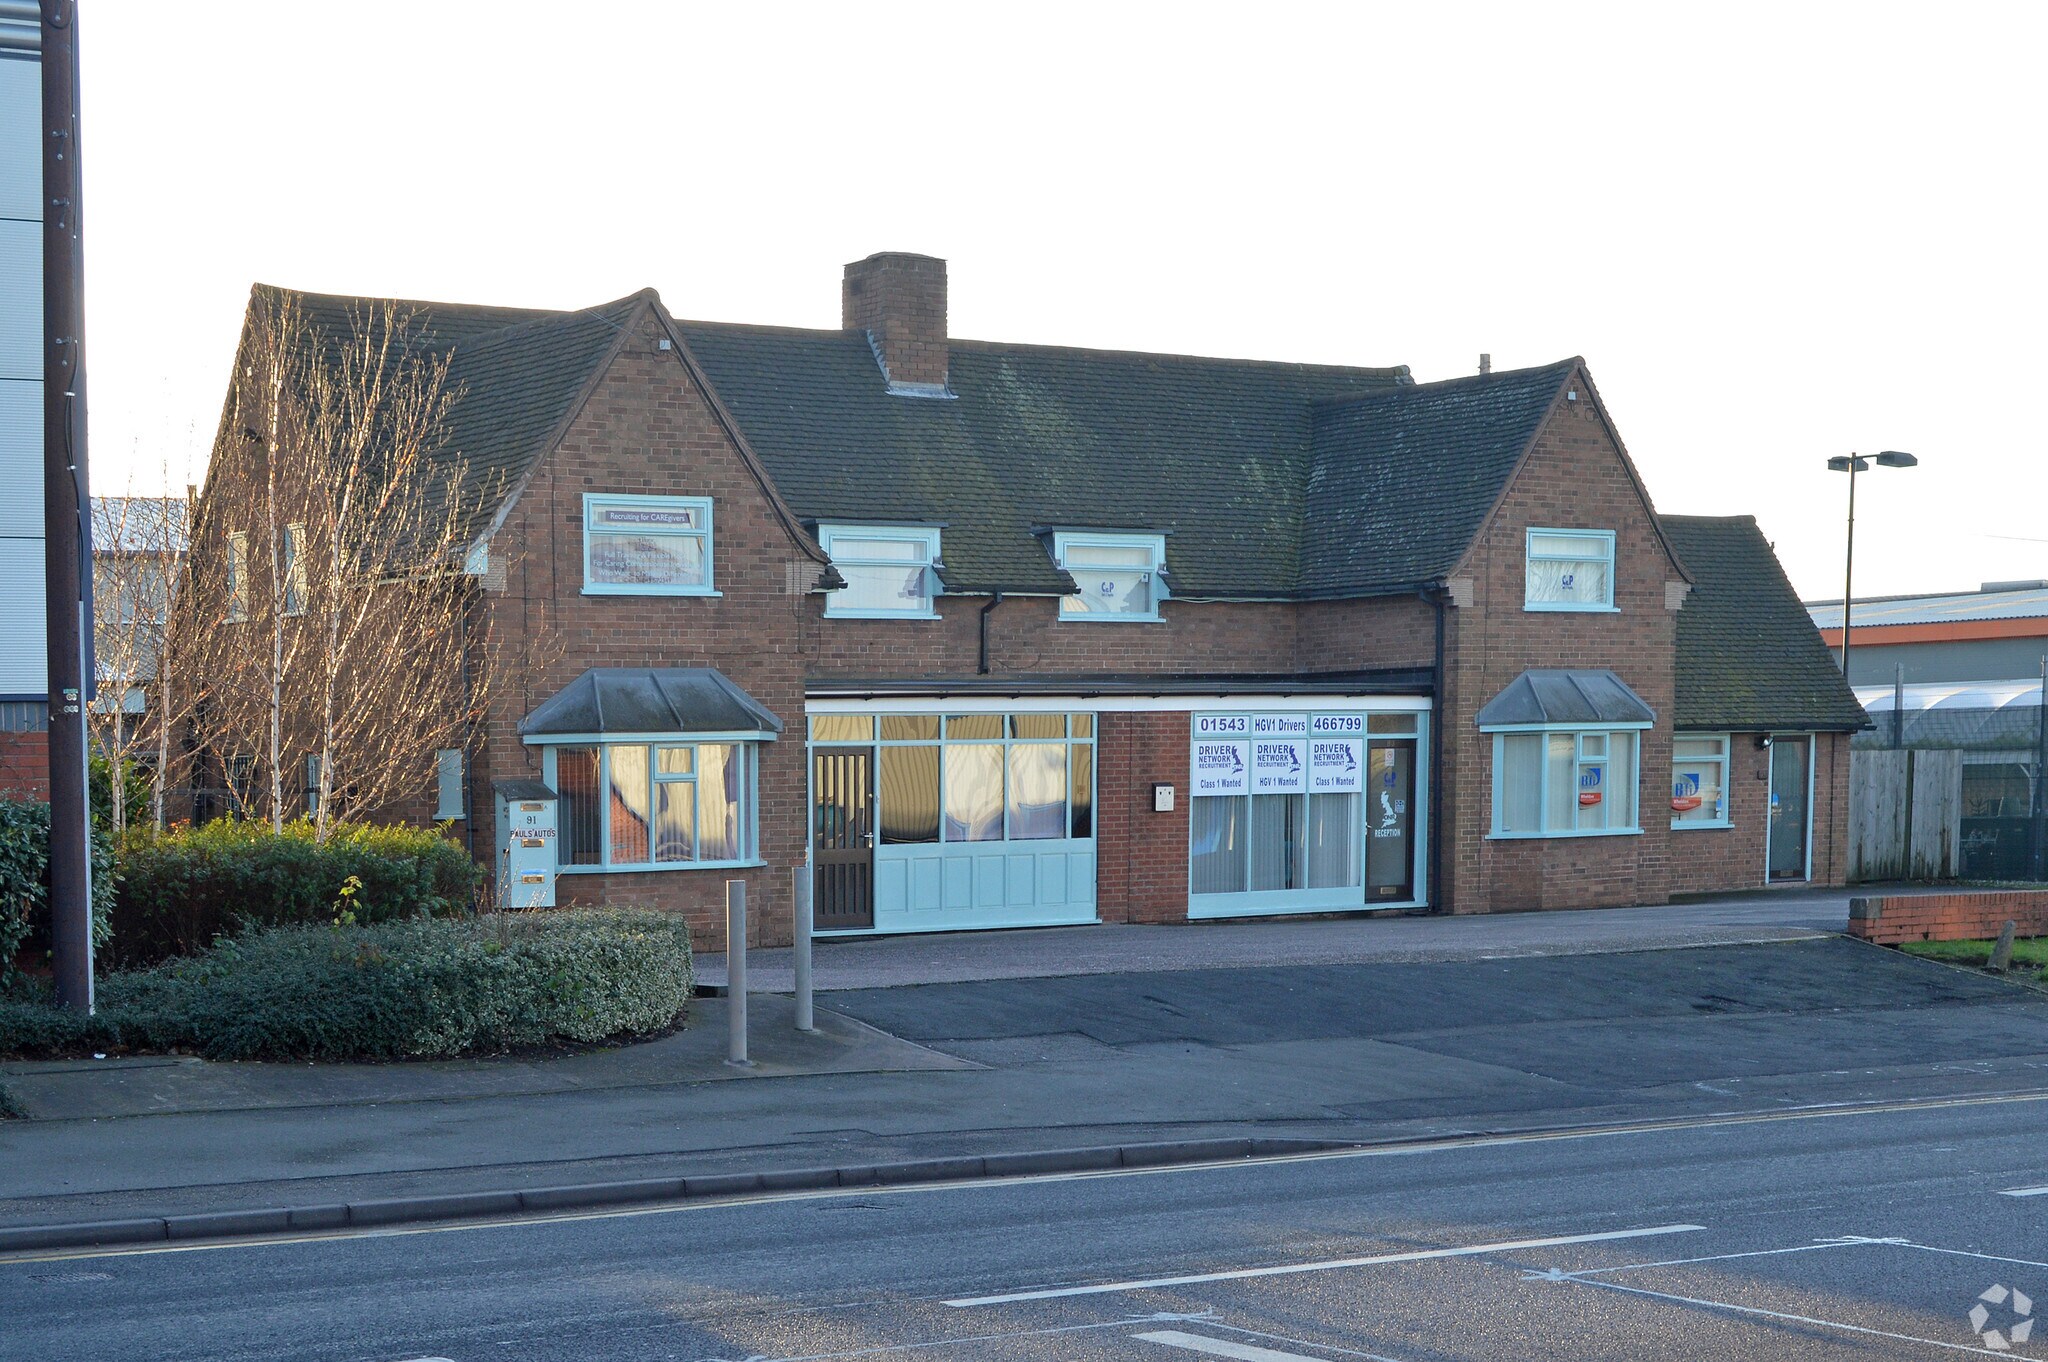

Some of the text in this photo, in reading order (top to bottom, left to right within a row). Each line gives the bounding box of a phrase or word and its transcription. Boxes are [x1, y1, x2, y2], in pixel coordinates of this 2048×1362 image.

[610, 512, 686, 523] Recruiting for CAREgivers
[1200, 718, 1245, 731] 01543
[1255, 718, 1306, 731] HGV1 Drivers
[1313, 717, 1361, 730] 466799
[1198, 745, 1231, 755] DRIVER
[1257, 744, 1289, 754] DRIVER
[1314, 743, 1345, 753] DRIVER
[1198, 755, 1231, 763] NETWORK
[1200, 779, 1216, 789] Class
[1221, 778, 1242, 788] Wanted
[1259, 777, 1272, 787] HGV
[1277, 777, 1298, 787] Wanted
[1315, 777, 1330, 787] Class
[1335, 776, 1355, 786] Wanted
[526, 816, 537, 825] 91
[1374, 829, 1401, 837] RECEPTION
